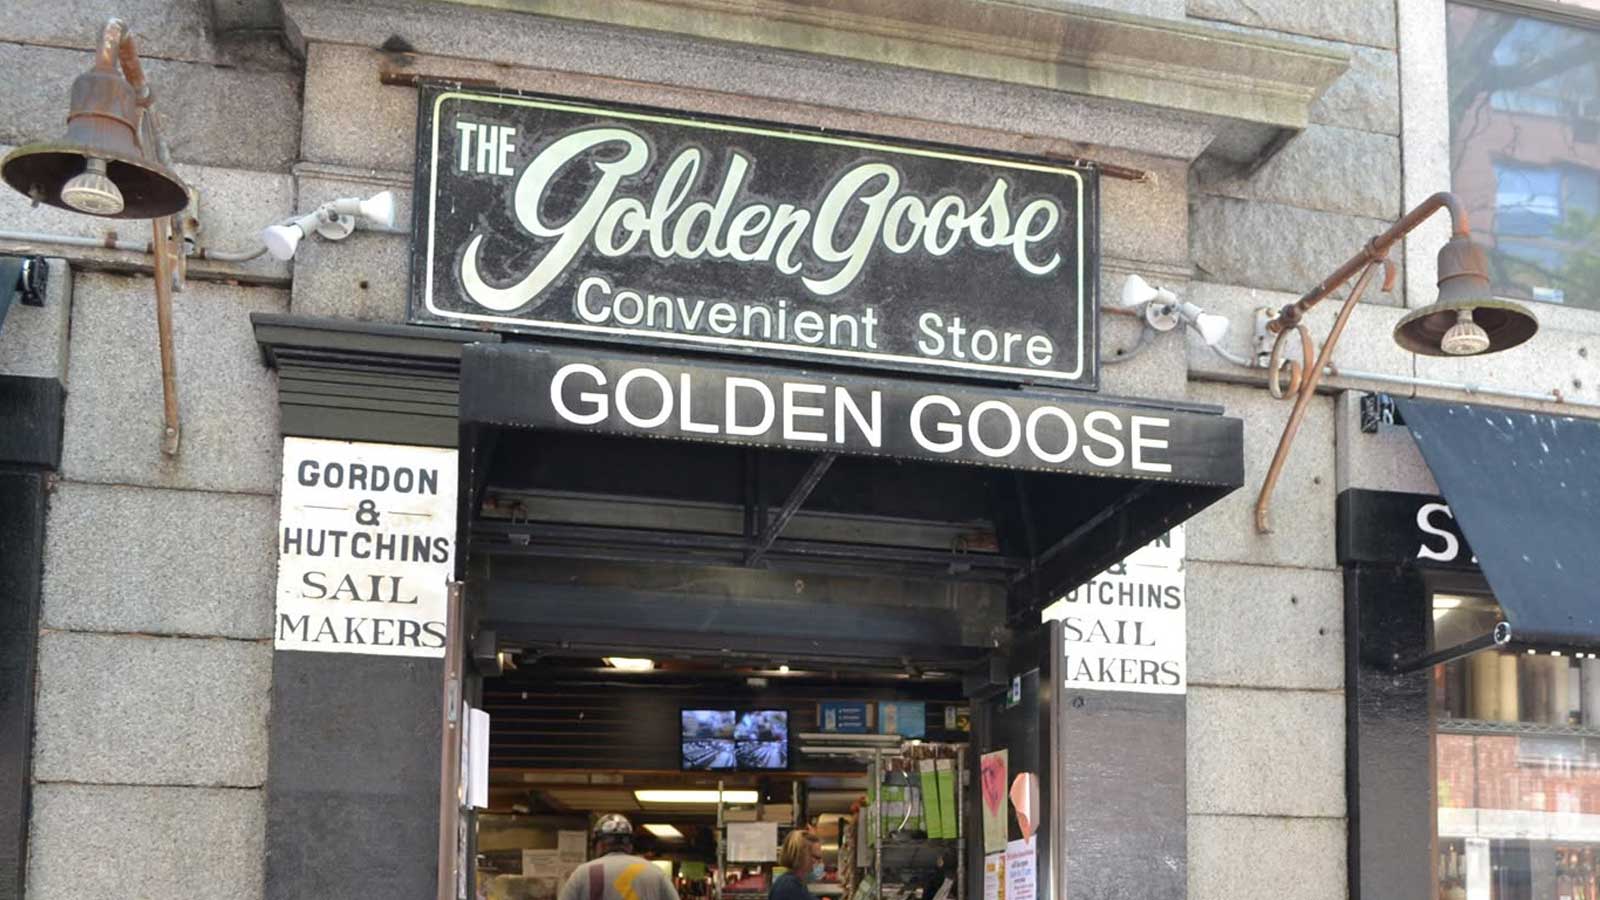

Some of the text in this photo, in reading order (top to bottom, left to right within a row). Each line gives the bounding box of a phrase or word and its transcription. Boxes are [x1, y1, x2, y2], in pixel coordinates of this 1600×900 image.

[456, 121, 516, 177] THE
[461, 127, 1061, 312] Golden Goose
[576, 277, 1055, 367] Convenient Store
[550, 362, 1173, 474] GOLDEN GOOSE
[298, 460, 438, 495] GORDON
[355, 499, 380, 526] &
[283, 528, 449, 563] HUTCHINS
[1416, 503, 1478, 563] S
[302, 571, 418, 604] SAIL
[279, 613, 446, 648] MAKERS
[1064, 617, 1156, 647] SAIL
